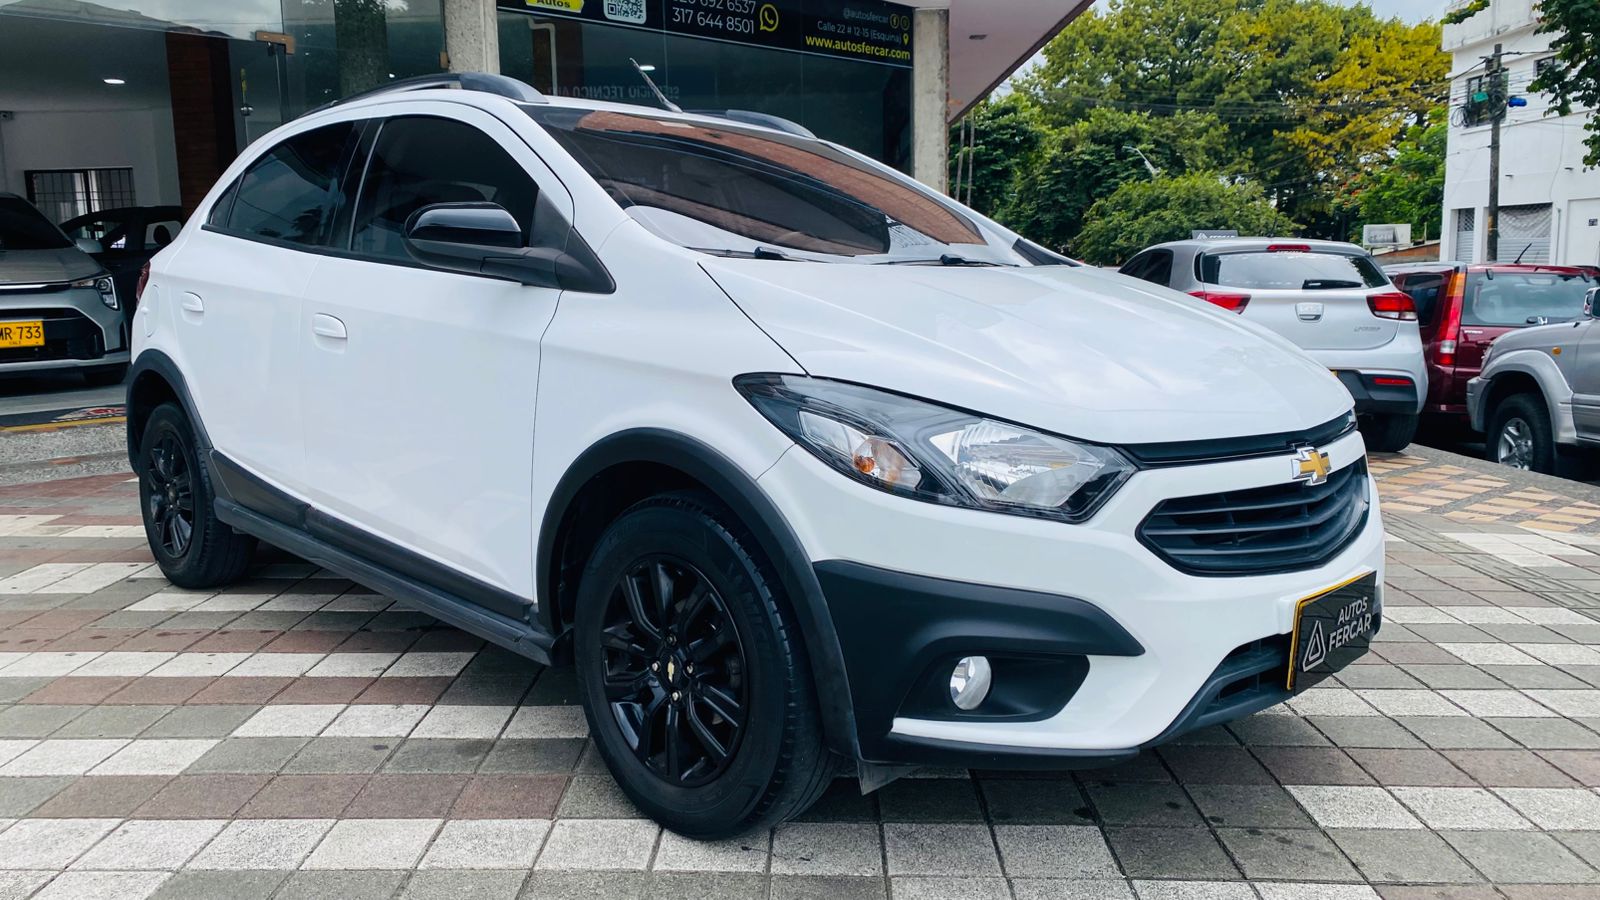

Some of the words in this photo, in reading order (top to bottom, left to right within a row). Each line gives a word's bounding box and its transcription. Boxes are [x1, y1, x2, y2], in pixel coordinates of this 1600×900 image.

[727, 0, 756, 15] 6537
[672, 7, 694, 24] 317
[697, 12, 723, 29] 644
[726, 17, 754, 34] 8501
[817, 21, 836, 32] Calle
[837, 25, 846, 34] 22
[805, 36, 910, 60] www.autosfercar.com
[16, 325, 41, 340] 733
[1337, 597, 1368, 625] AUTOS
[1328, 613, 1372, 652] FERCAR
